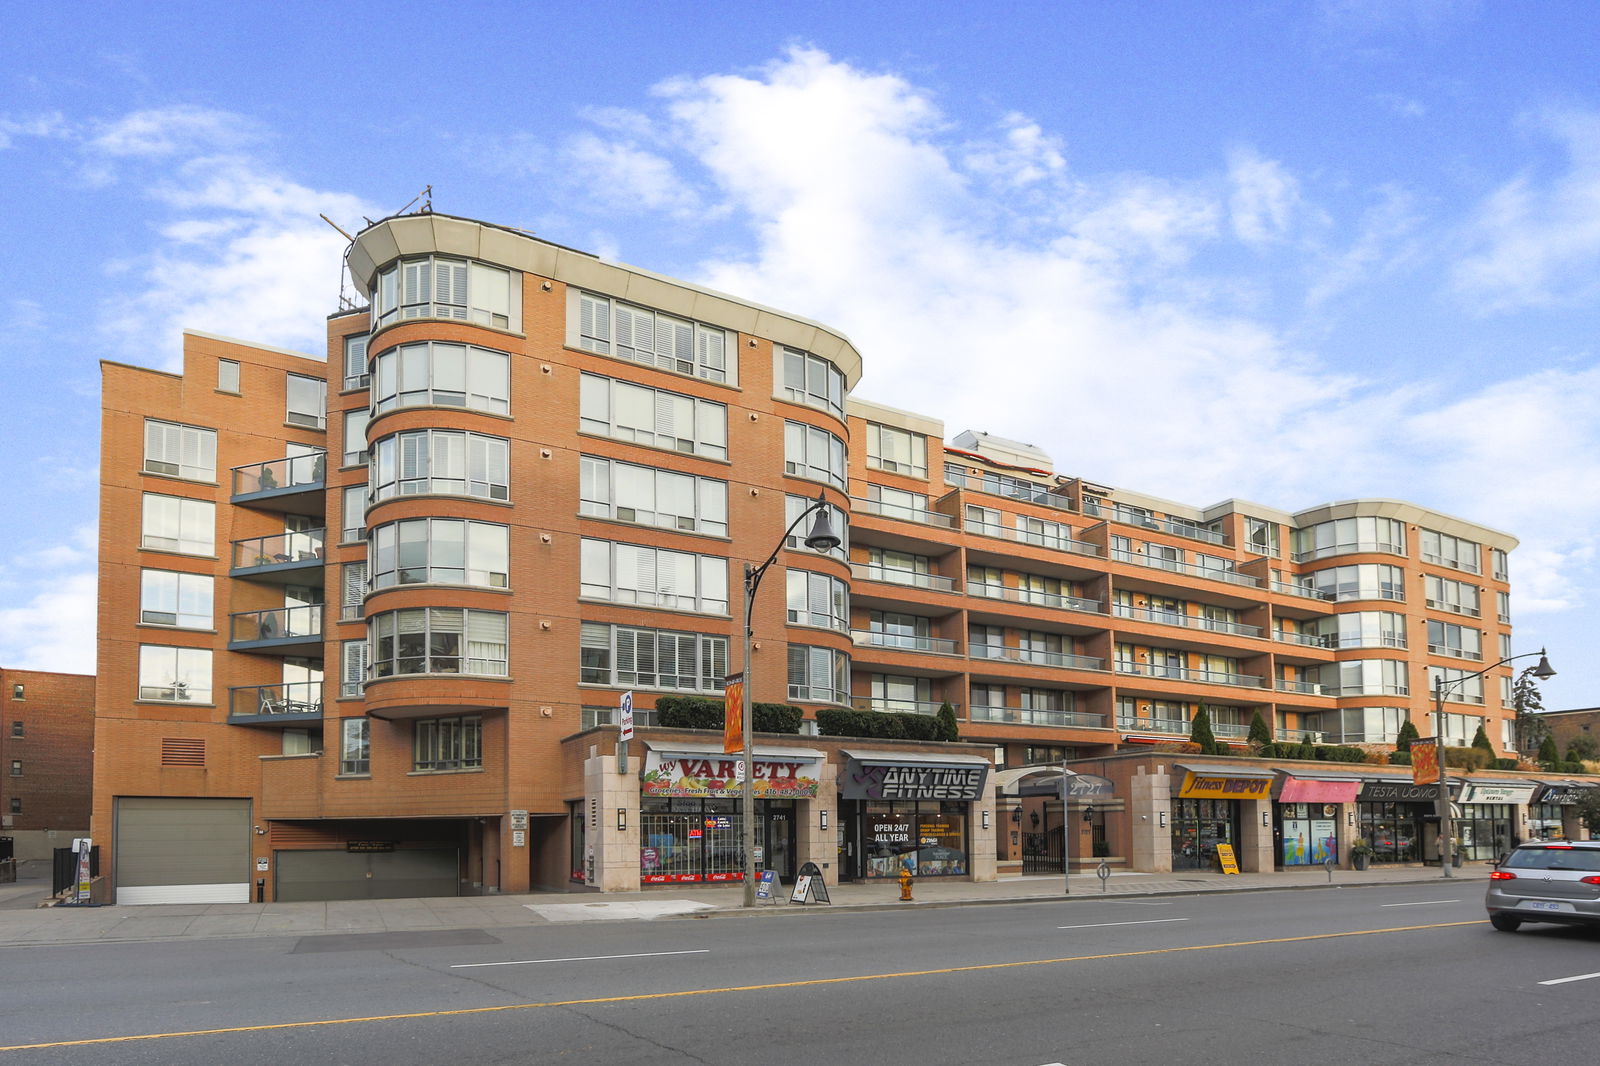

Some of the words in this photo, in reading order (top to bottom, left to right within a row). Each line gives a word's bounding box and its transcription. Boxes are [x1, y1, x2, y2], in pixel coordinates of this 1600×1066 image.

[679, 759, 804, 779] VARETY
[883, 767, 981, 786] ANYTIME
[882, 785, 978, 799] FITNESS
[1222, 778, 1268, 793] DEPOT
[1368, 786, 1398, 798] TESTA
[1402, 787, 1438, 798] UOMO
[874, 824, 893, 832] OPEN
[894, 824, 909, 832] 24/7
[875, 834, 889, 842] ALL
[890, 834, 909, 842] YEAR
